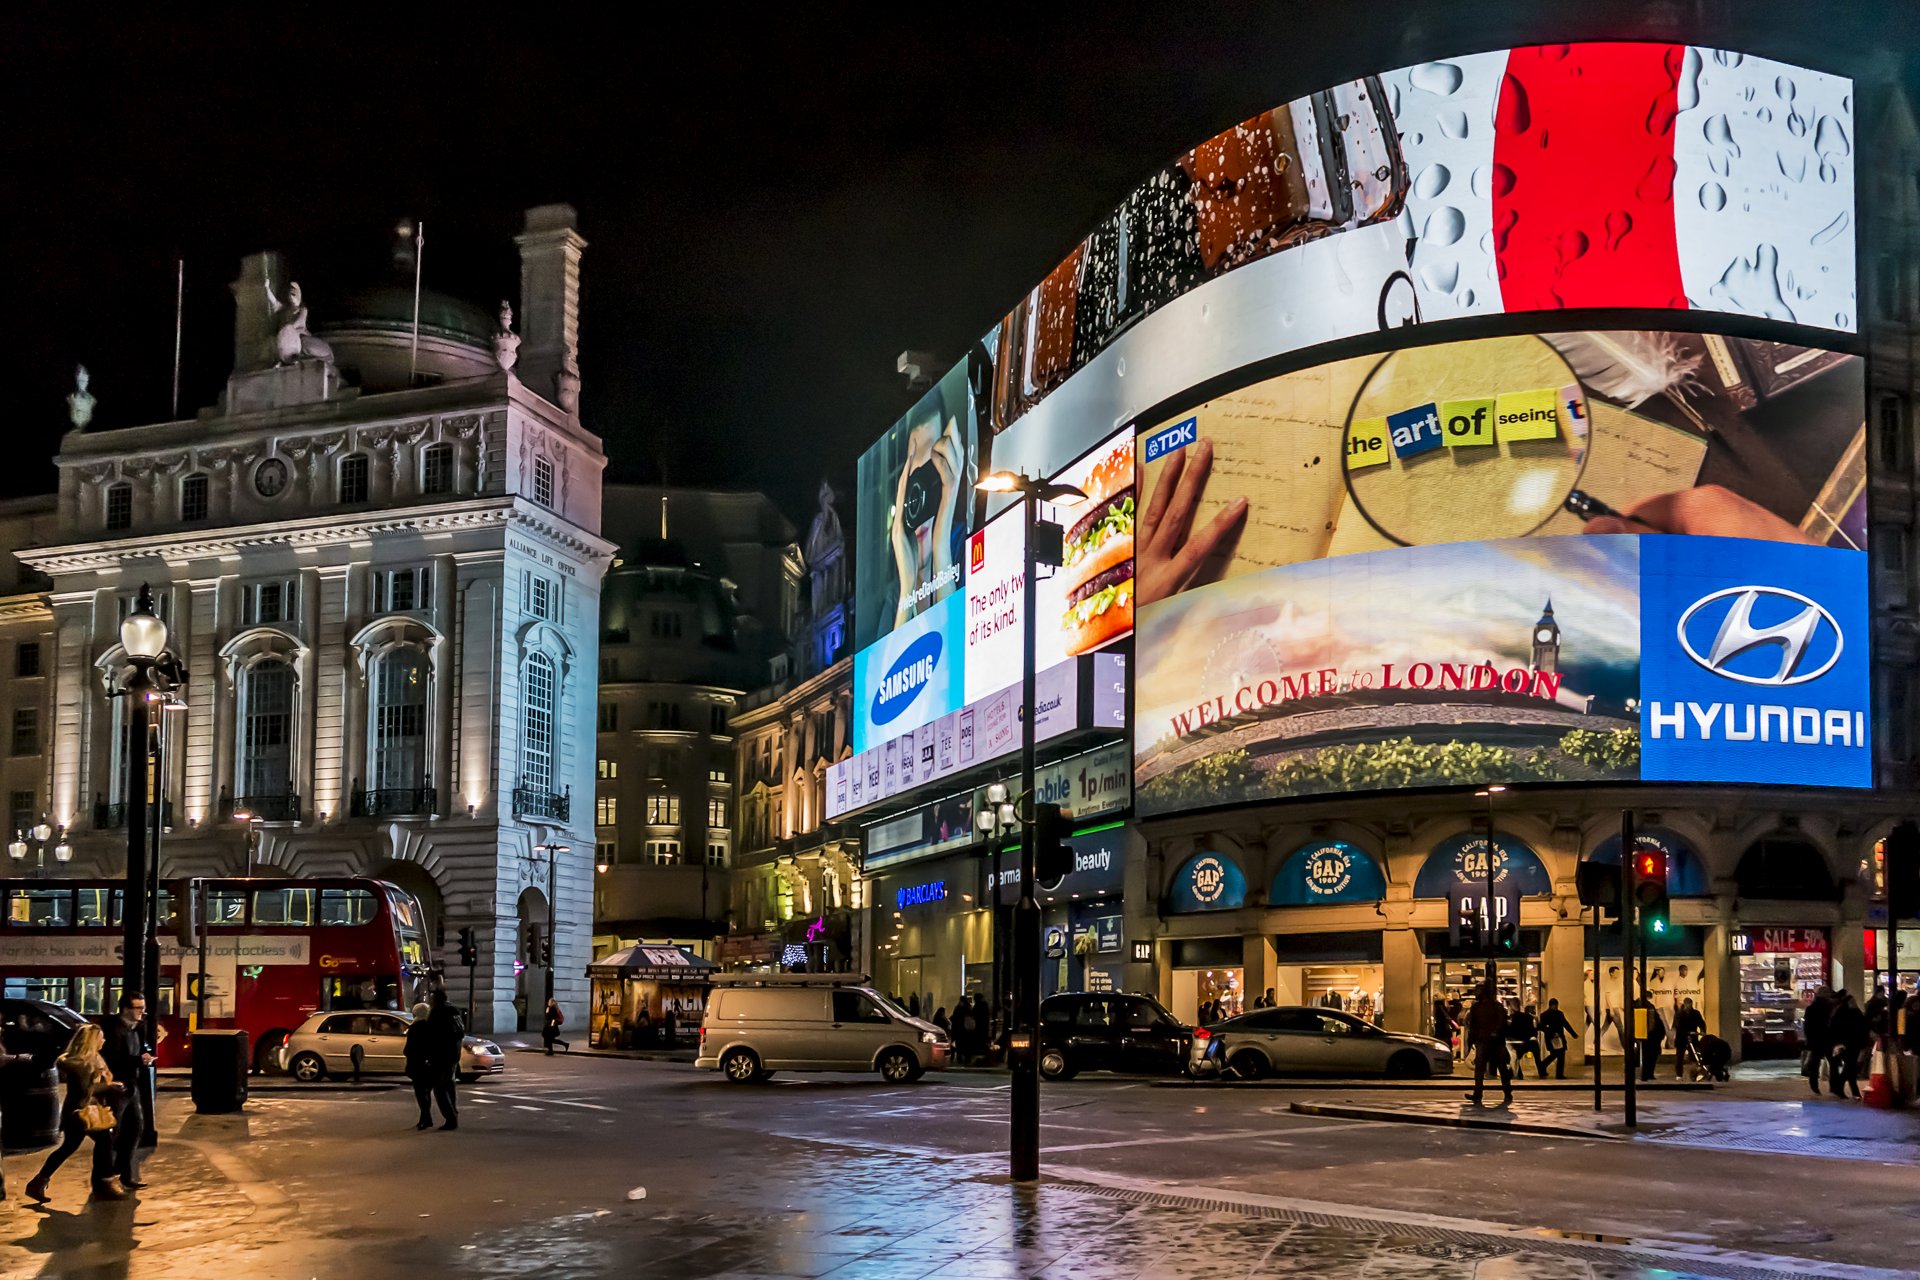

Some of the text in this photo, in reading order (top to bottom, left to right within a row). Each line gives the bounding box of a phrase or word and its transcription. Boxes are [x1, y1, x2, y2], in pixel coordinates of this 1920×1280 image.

[1157, 422, 1193, 451] TDK
[1392, 413, 1441, 448] art
[1448, 407, 1486, 436] of
[1499, 408, 1557, 424] seeing
[509, 538, 576, 576] ALLIANCE LIFE OFFICE
[970, 571, 1025, 617] The only tw
[970, 603, 1017, 645] of its kind.
[879, 655, 933, 704] SAMSUNG
[1034, 694, 1062, 716] edia.co.uk
[1170, 661, 1565, 738] WELCOME to LONDON
[962, 726, 972, 739] DOE
[1650, 701, 1864, 748] HYUNDAI
[1035, 775, 1070, 803] obile
[1342, 855, 1351, 868] USA
[1464, 853, 1501, 872] GAP
[1499, 849, 1509, 862] USA
[988, 847, 1111, 890] parma beauty
[1197, 870, 1220, 887] GAP
[1313, 860, 1345, 879] GAP
[905, 881, 944, 906] BARCLAYS
[1305, 875, 1351, 894] LONDON EDITION
[1461, 896, 1507, 931] GAP
[24, 946, 47, 957] the
[49, 944, 76, 957] bus
[78, 944, 108, 957] with
[214, 944, 285, 957] contactless
[1135, 944, 1150, 959] GAP
[1731, 935, 1748, 951] GAP
[1763, 929, 1796, 952] SALE
[1650, 988, 1672, 996] Denim
